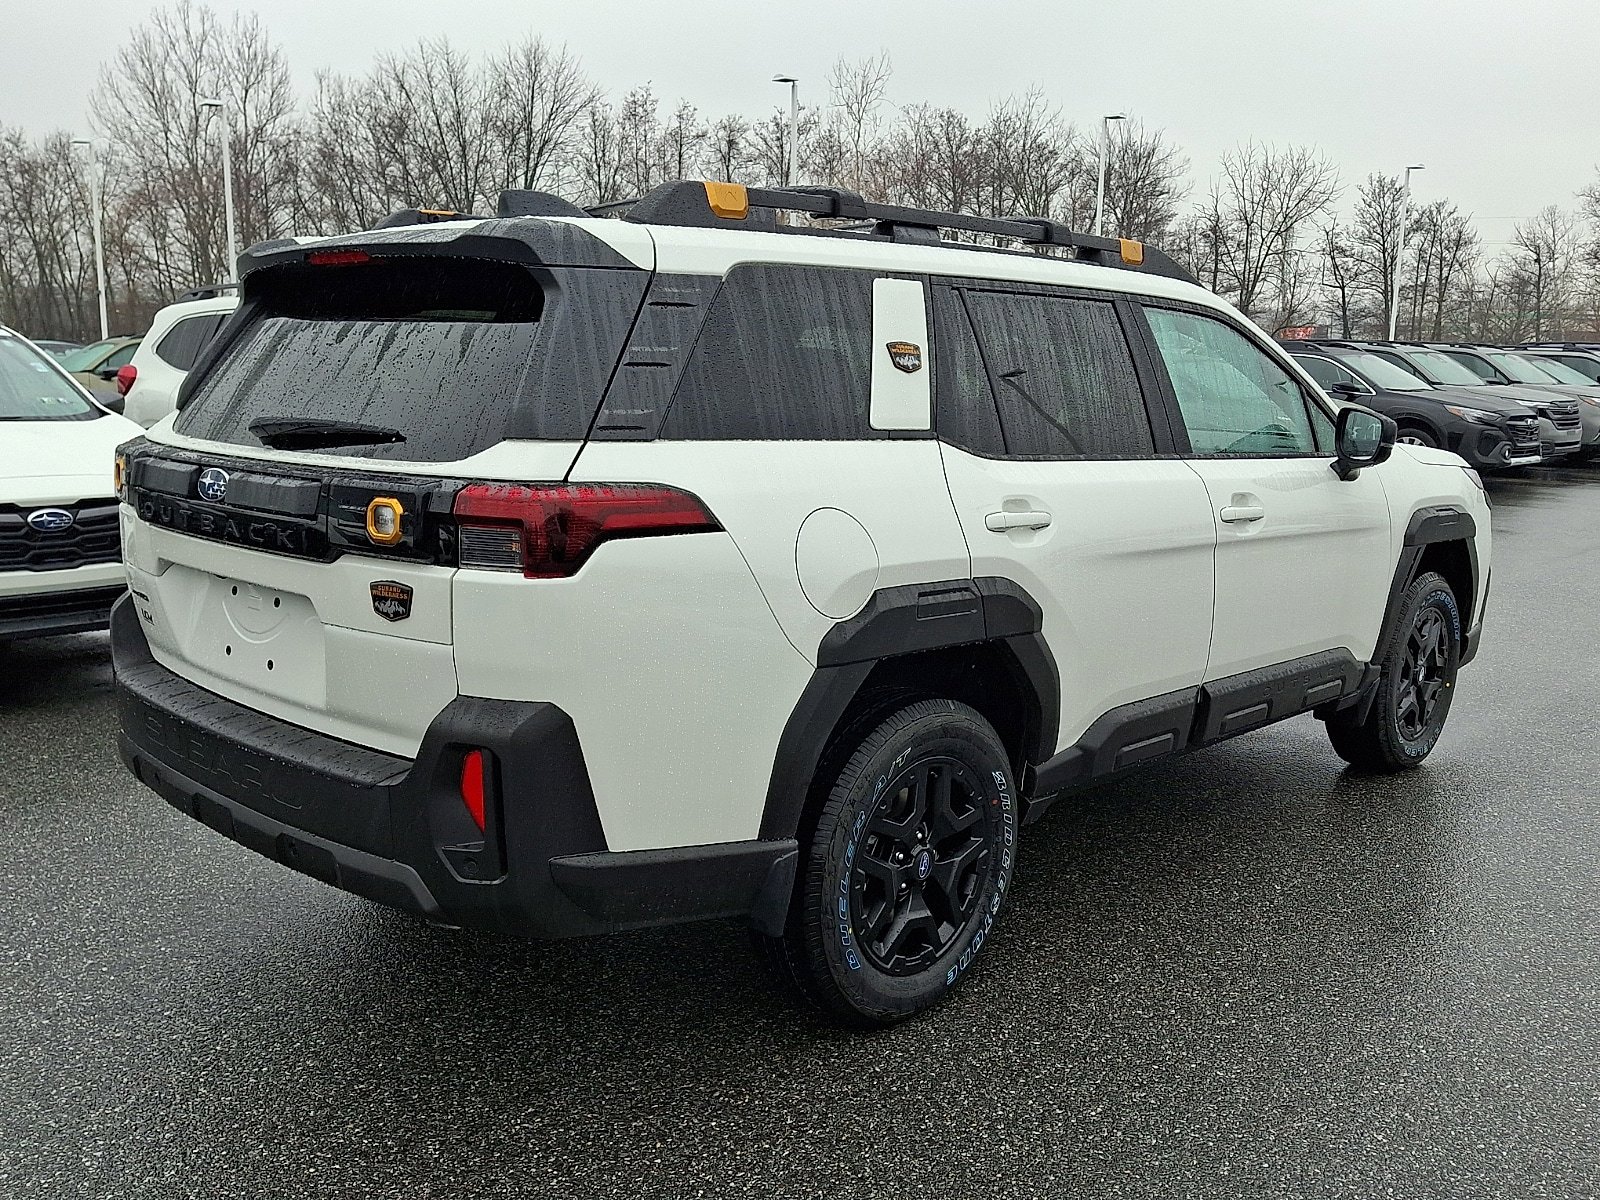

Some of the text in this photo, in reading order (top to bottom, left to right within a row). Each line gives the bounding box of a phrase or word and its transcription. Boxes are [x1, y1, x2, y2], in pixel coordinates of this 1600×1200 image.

[142, 501, 295, 549] OUTBACK
[372, 590, 408, 600] WILDERNESS
[377, 585, 402, 593] SUBARU
[946, 770, 1012, 986] BRIDGESTONE
